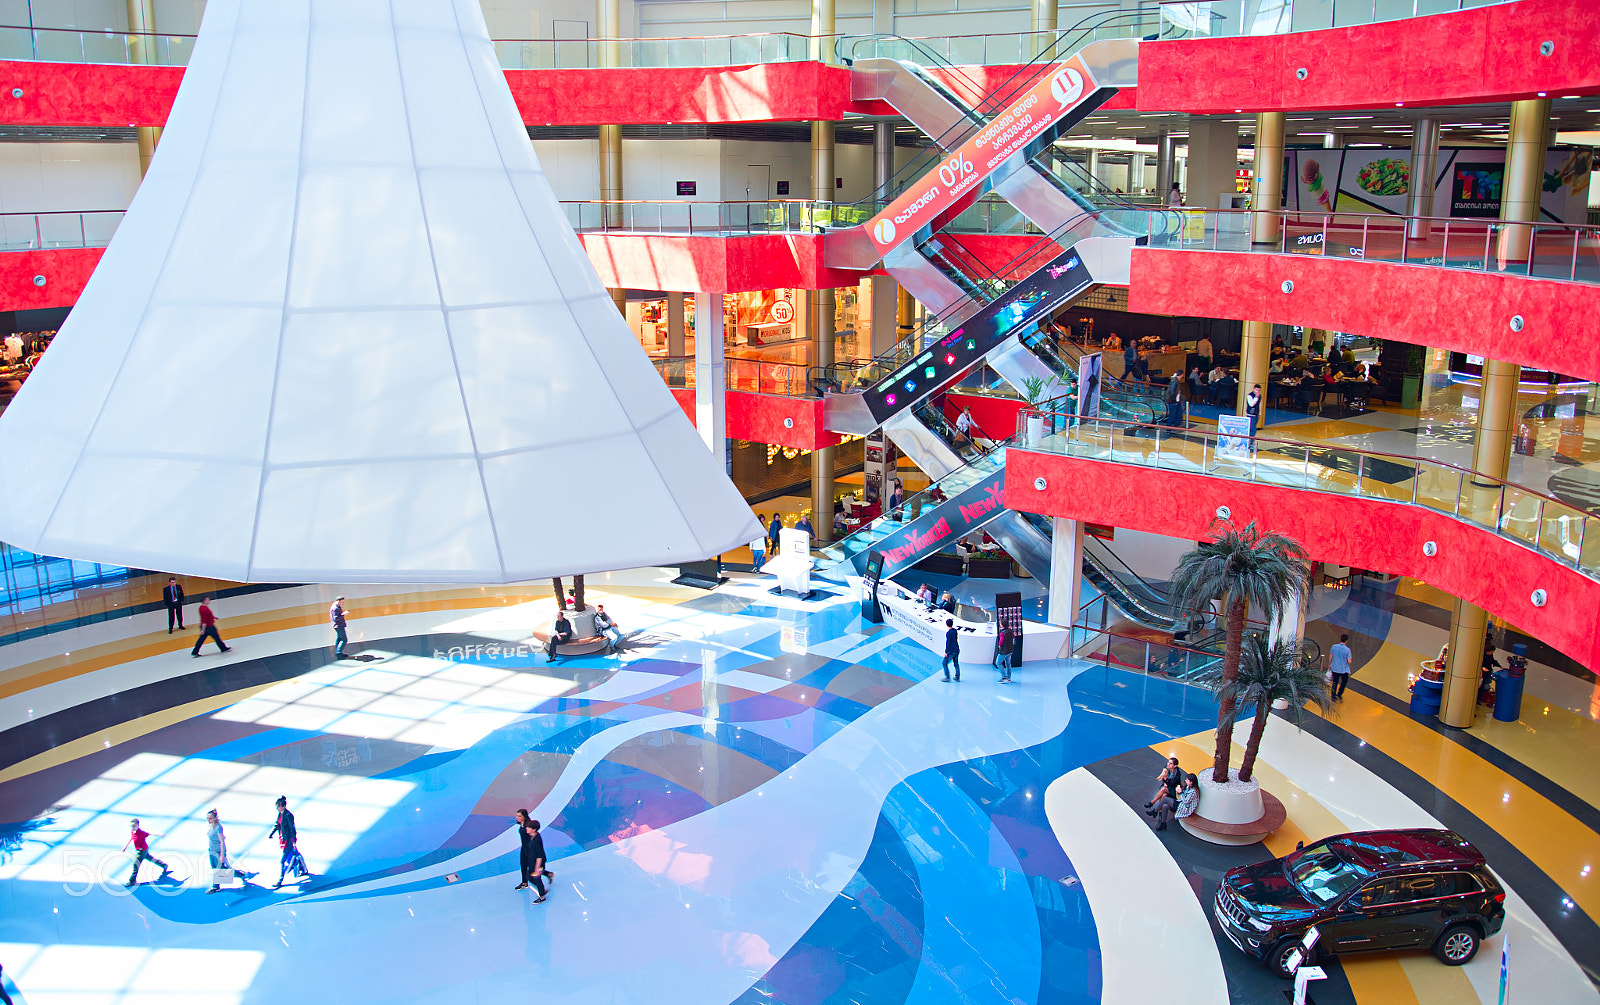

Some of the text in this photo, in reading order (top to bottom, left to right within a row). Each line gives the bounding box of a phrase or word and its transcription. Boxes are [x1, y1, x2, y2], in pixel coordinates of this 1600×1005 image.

[975, 113, 1014, 149] ტექნიკის
[1012, 93, 1038, 120] დიდი
[992, 113, 1033, 150] არჩევანი
[938, 151, 975, 189] 0%
[1457, 171, 1502, 199] TM
[894, 186, 940, 226] ზუმერი
